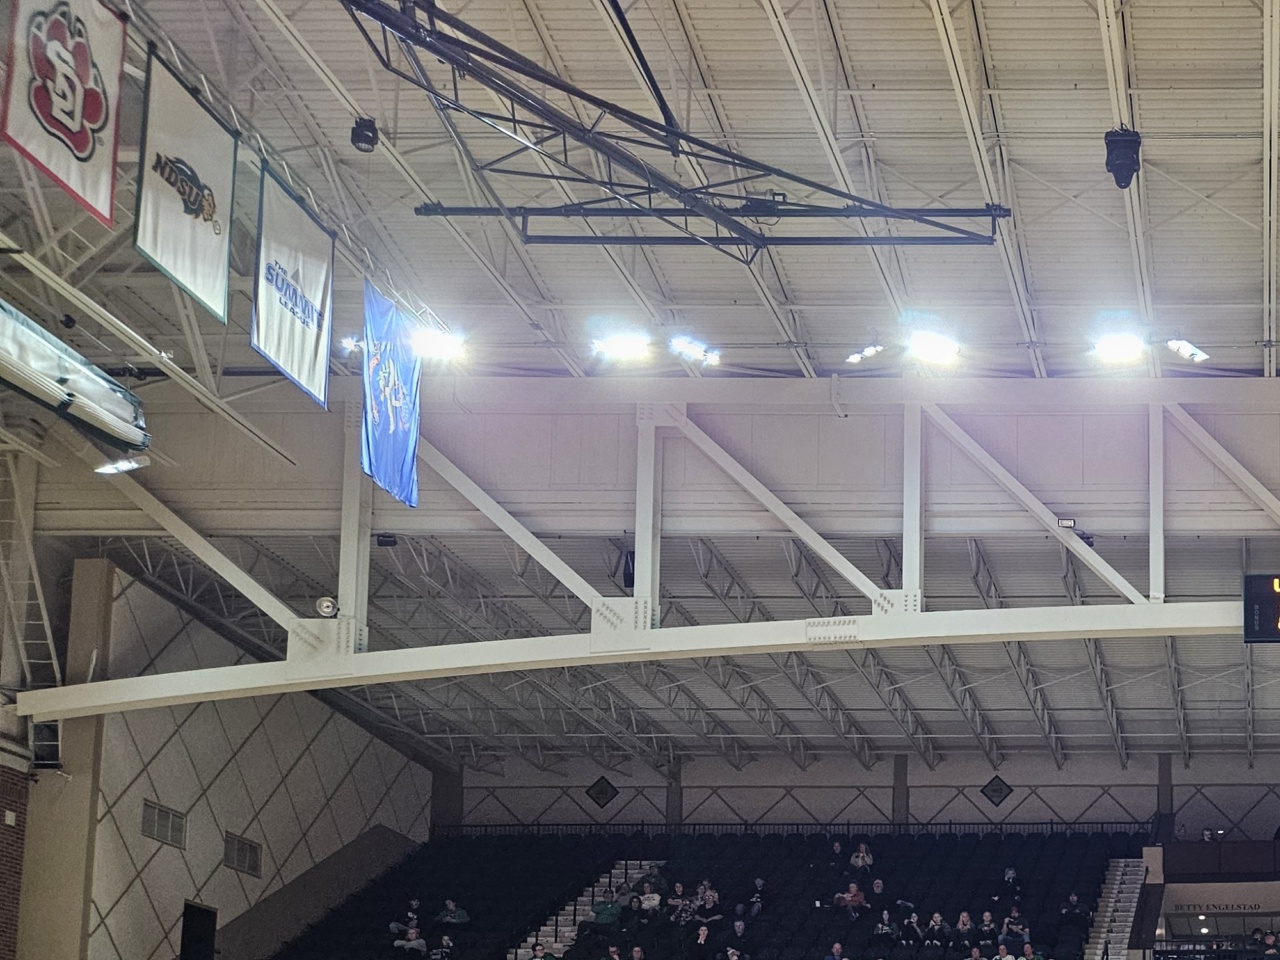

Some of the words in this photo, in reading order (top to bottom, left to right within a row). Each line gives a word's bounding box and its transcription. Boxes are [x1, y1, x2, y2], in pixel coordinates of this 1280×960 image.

[152, 152, 200, 208] NDSU
[274, 260, 288, 277] THE
[265, 262, 325, 331] SUMMIT
[279, 297, 311, 330] LEAGUE
[1206, 903, 1261, 911] ENGELSTAD
